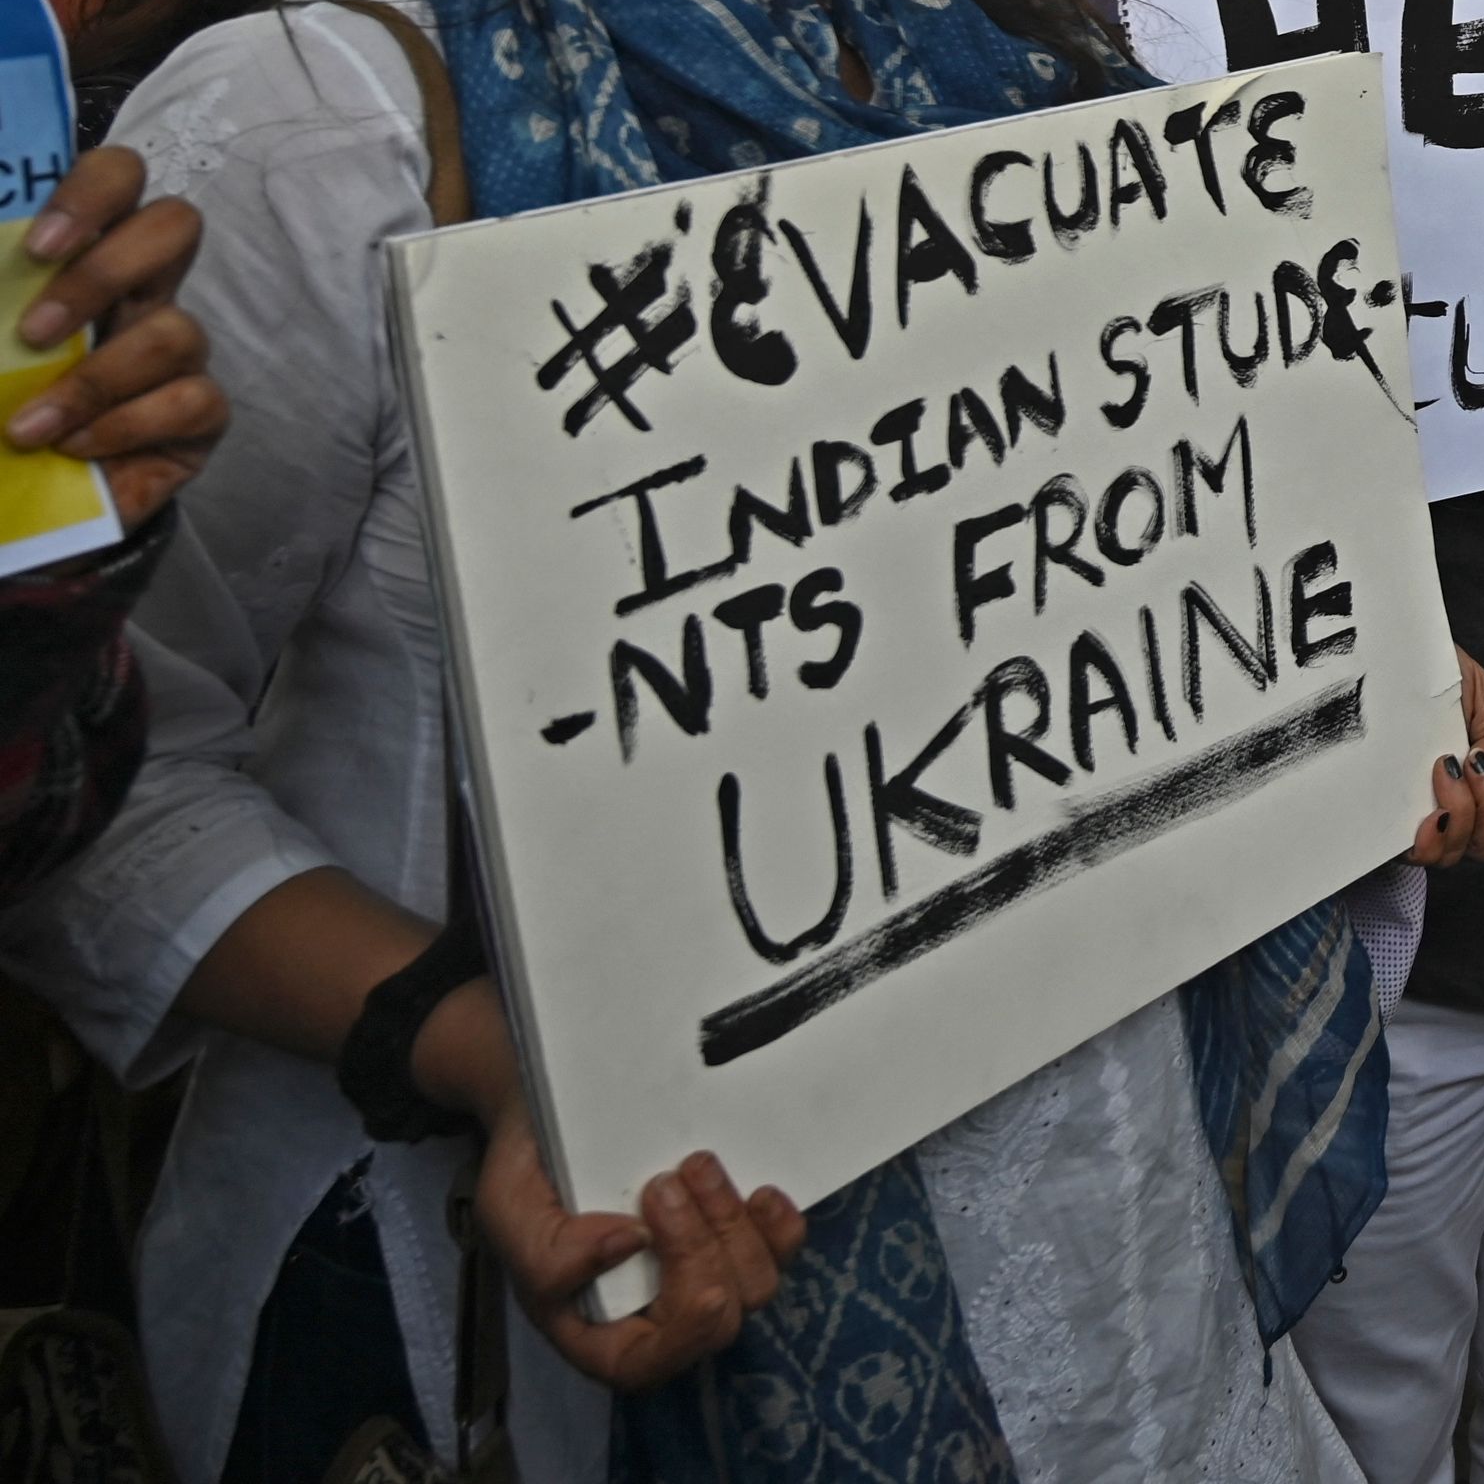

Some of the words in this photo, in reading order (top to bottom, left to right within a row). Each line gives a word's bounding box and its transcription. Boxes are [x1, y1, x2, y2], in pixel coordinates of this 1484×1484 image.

[570, 350, 1066, 617] INDIAN
[951, 415, 1259, 650] FROM
[717, 538, 1358, 966] UKRAINE
